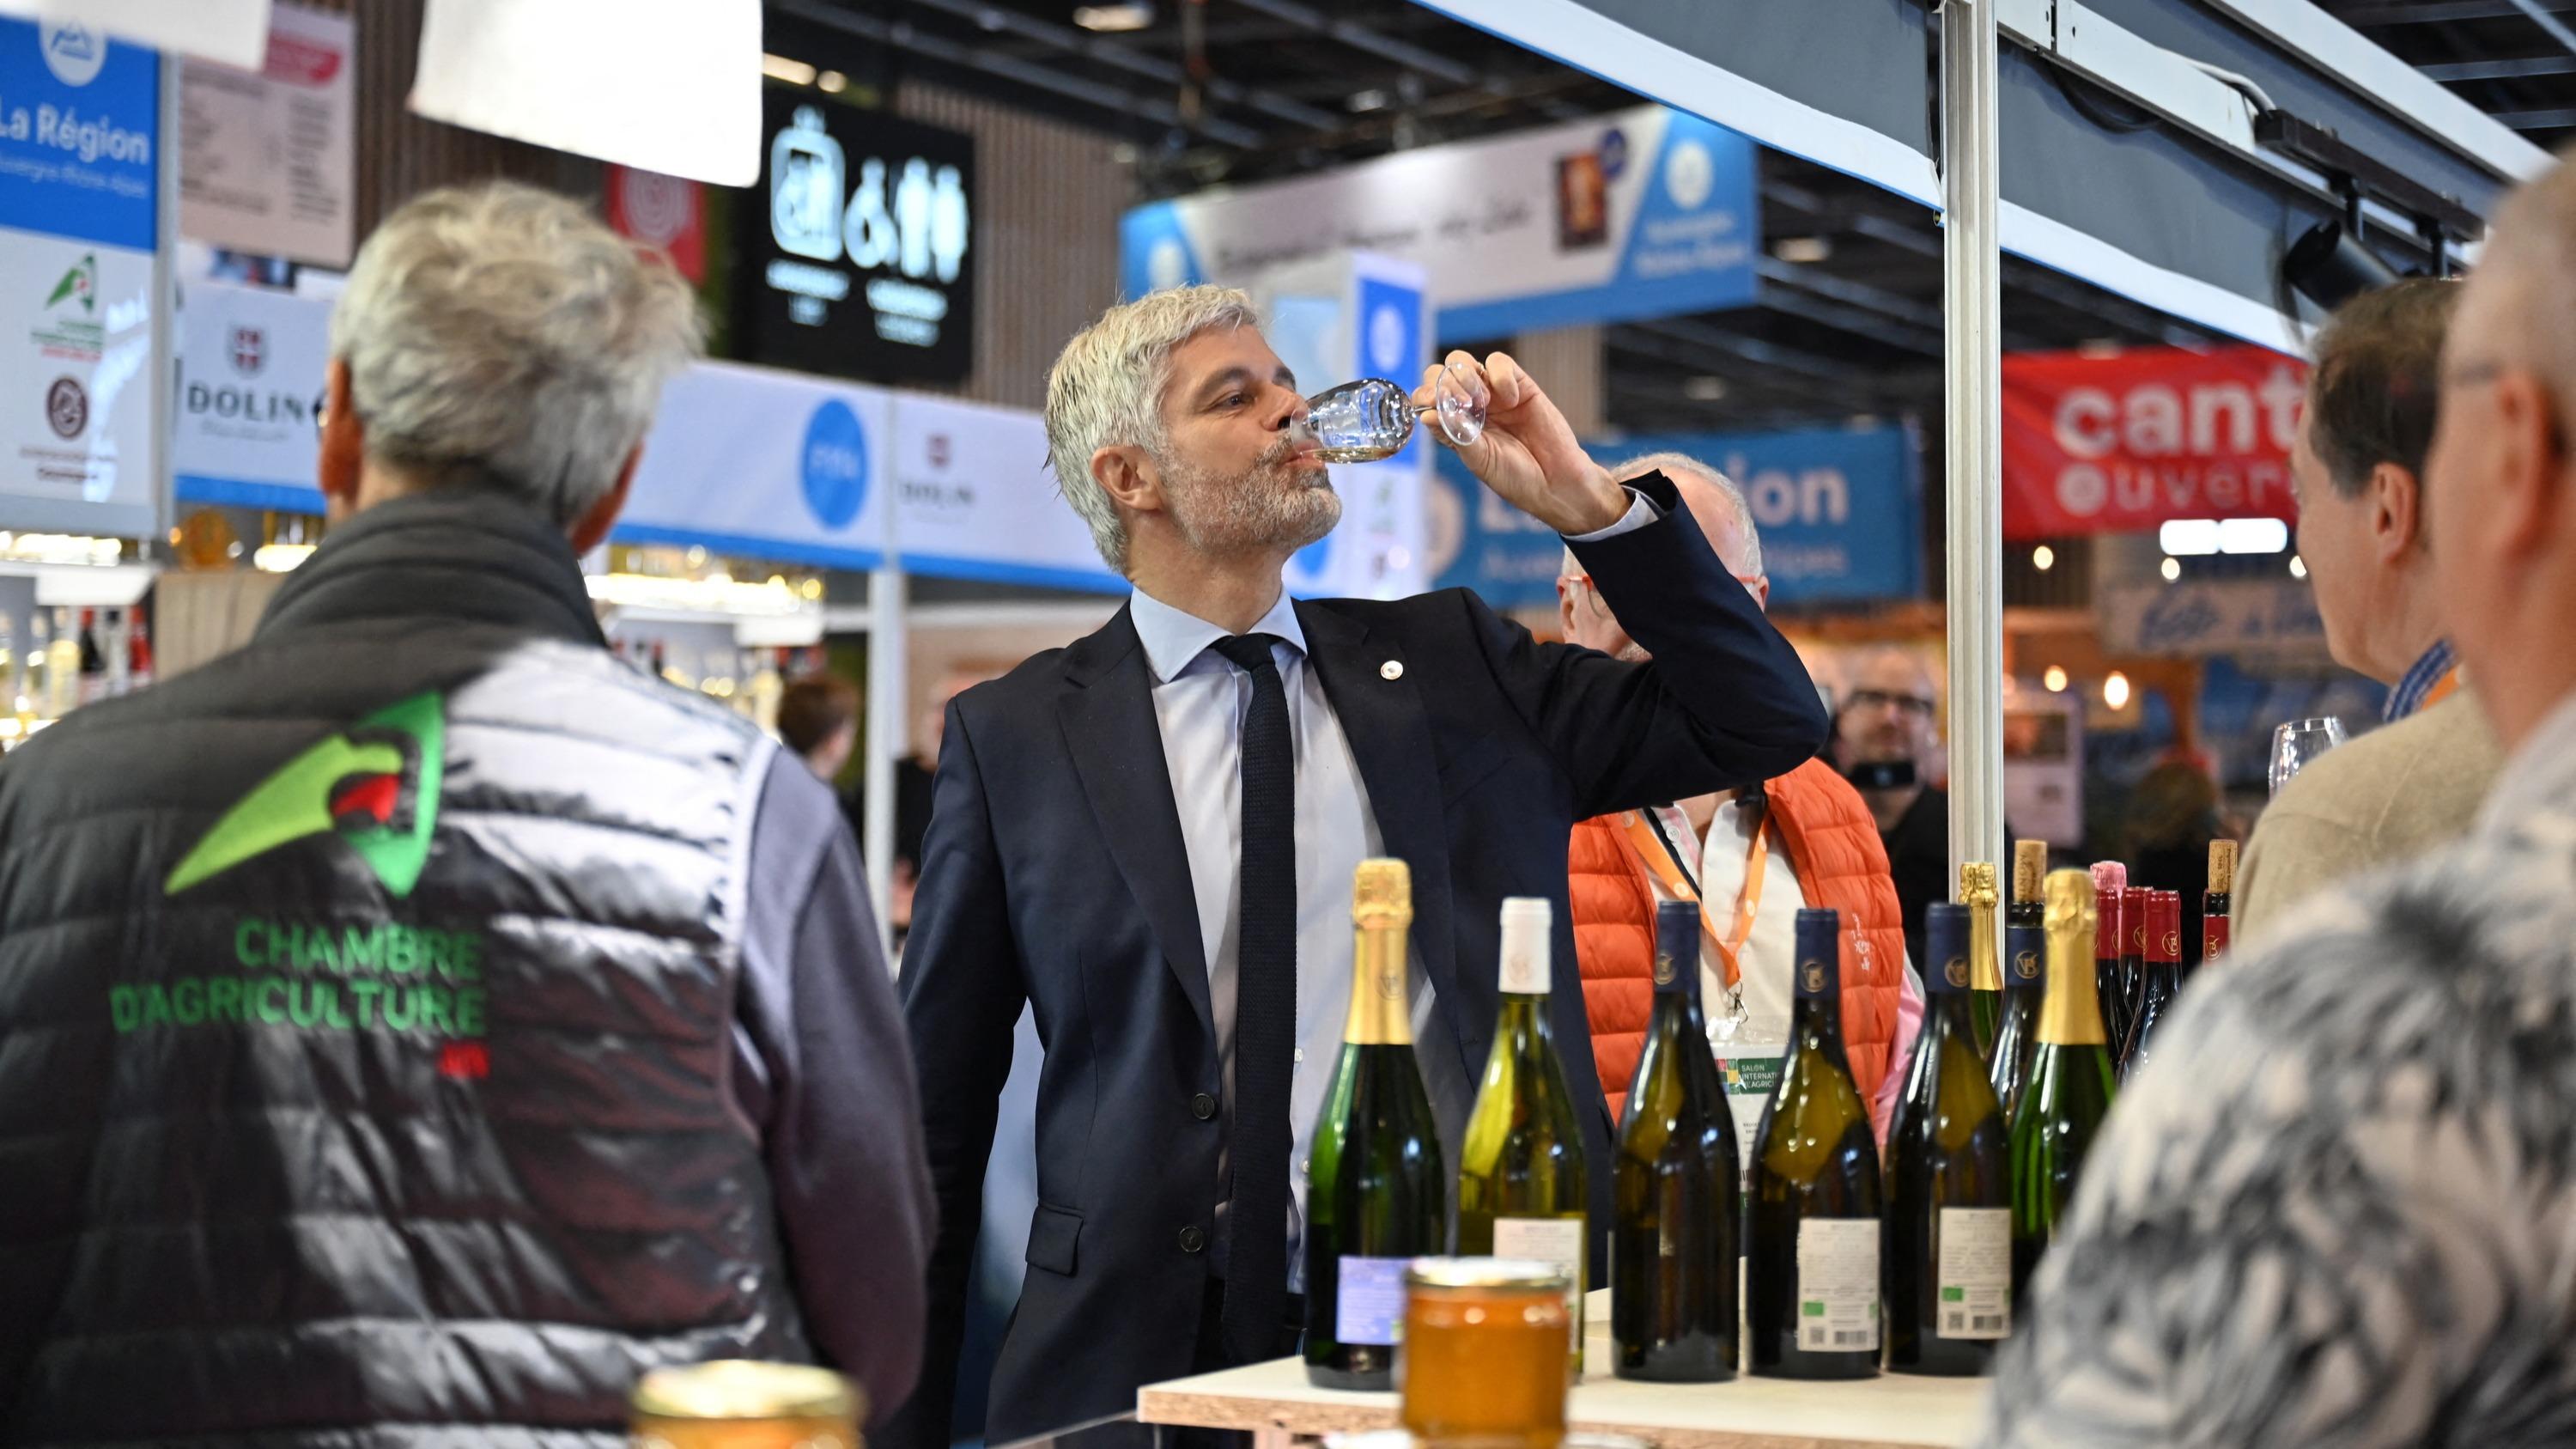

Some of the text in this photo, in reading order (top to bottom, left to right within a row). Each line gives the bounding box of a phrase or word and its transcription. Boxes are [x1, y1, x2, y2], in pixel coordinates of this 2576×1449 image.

[37, 102, 150, 165] Région
[186, 381, 306, 424] DOLIN
[2053, 364, 2303, 459] cant
[2055, 461, 2294, 516] ouver
[234, 916, 483, 979] CHAMBRE
[110, 976, 486, 1037] D'AGRICULTURE
[1741, 1072, 1780, 1081] INTERNATI
[1747, 1080, 1775, 1088] L'AGRIC
